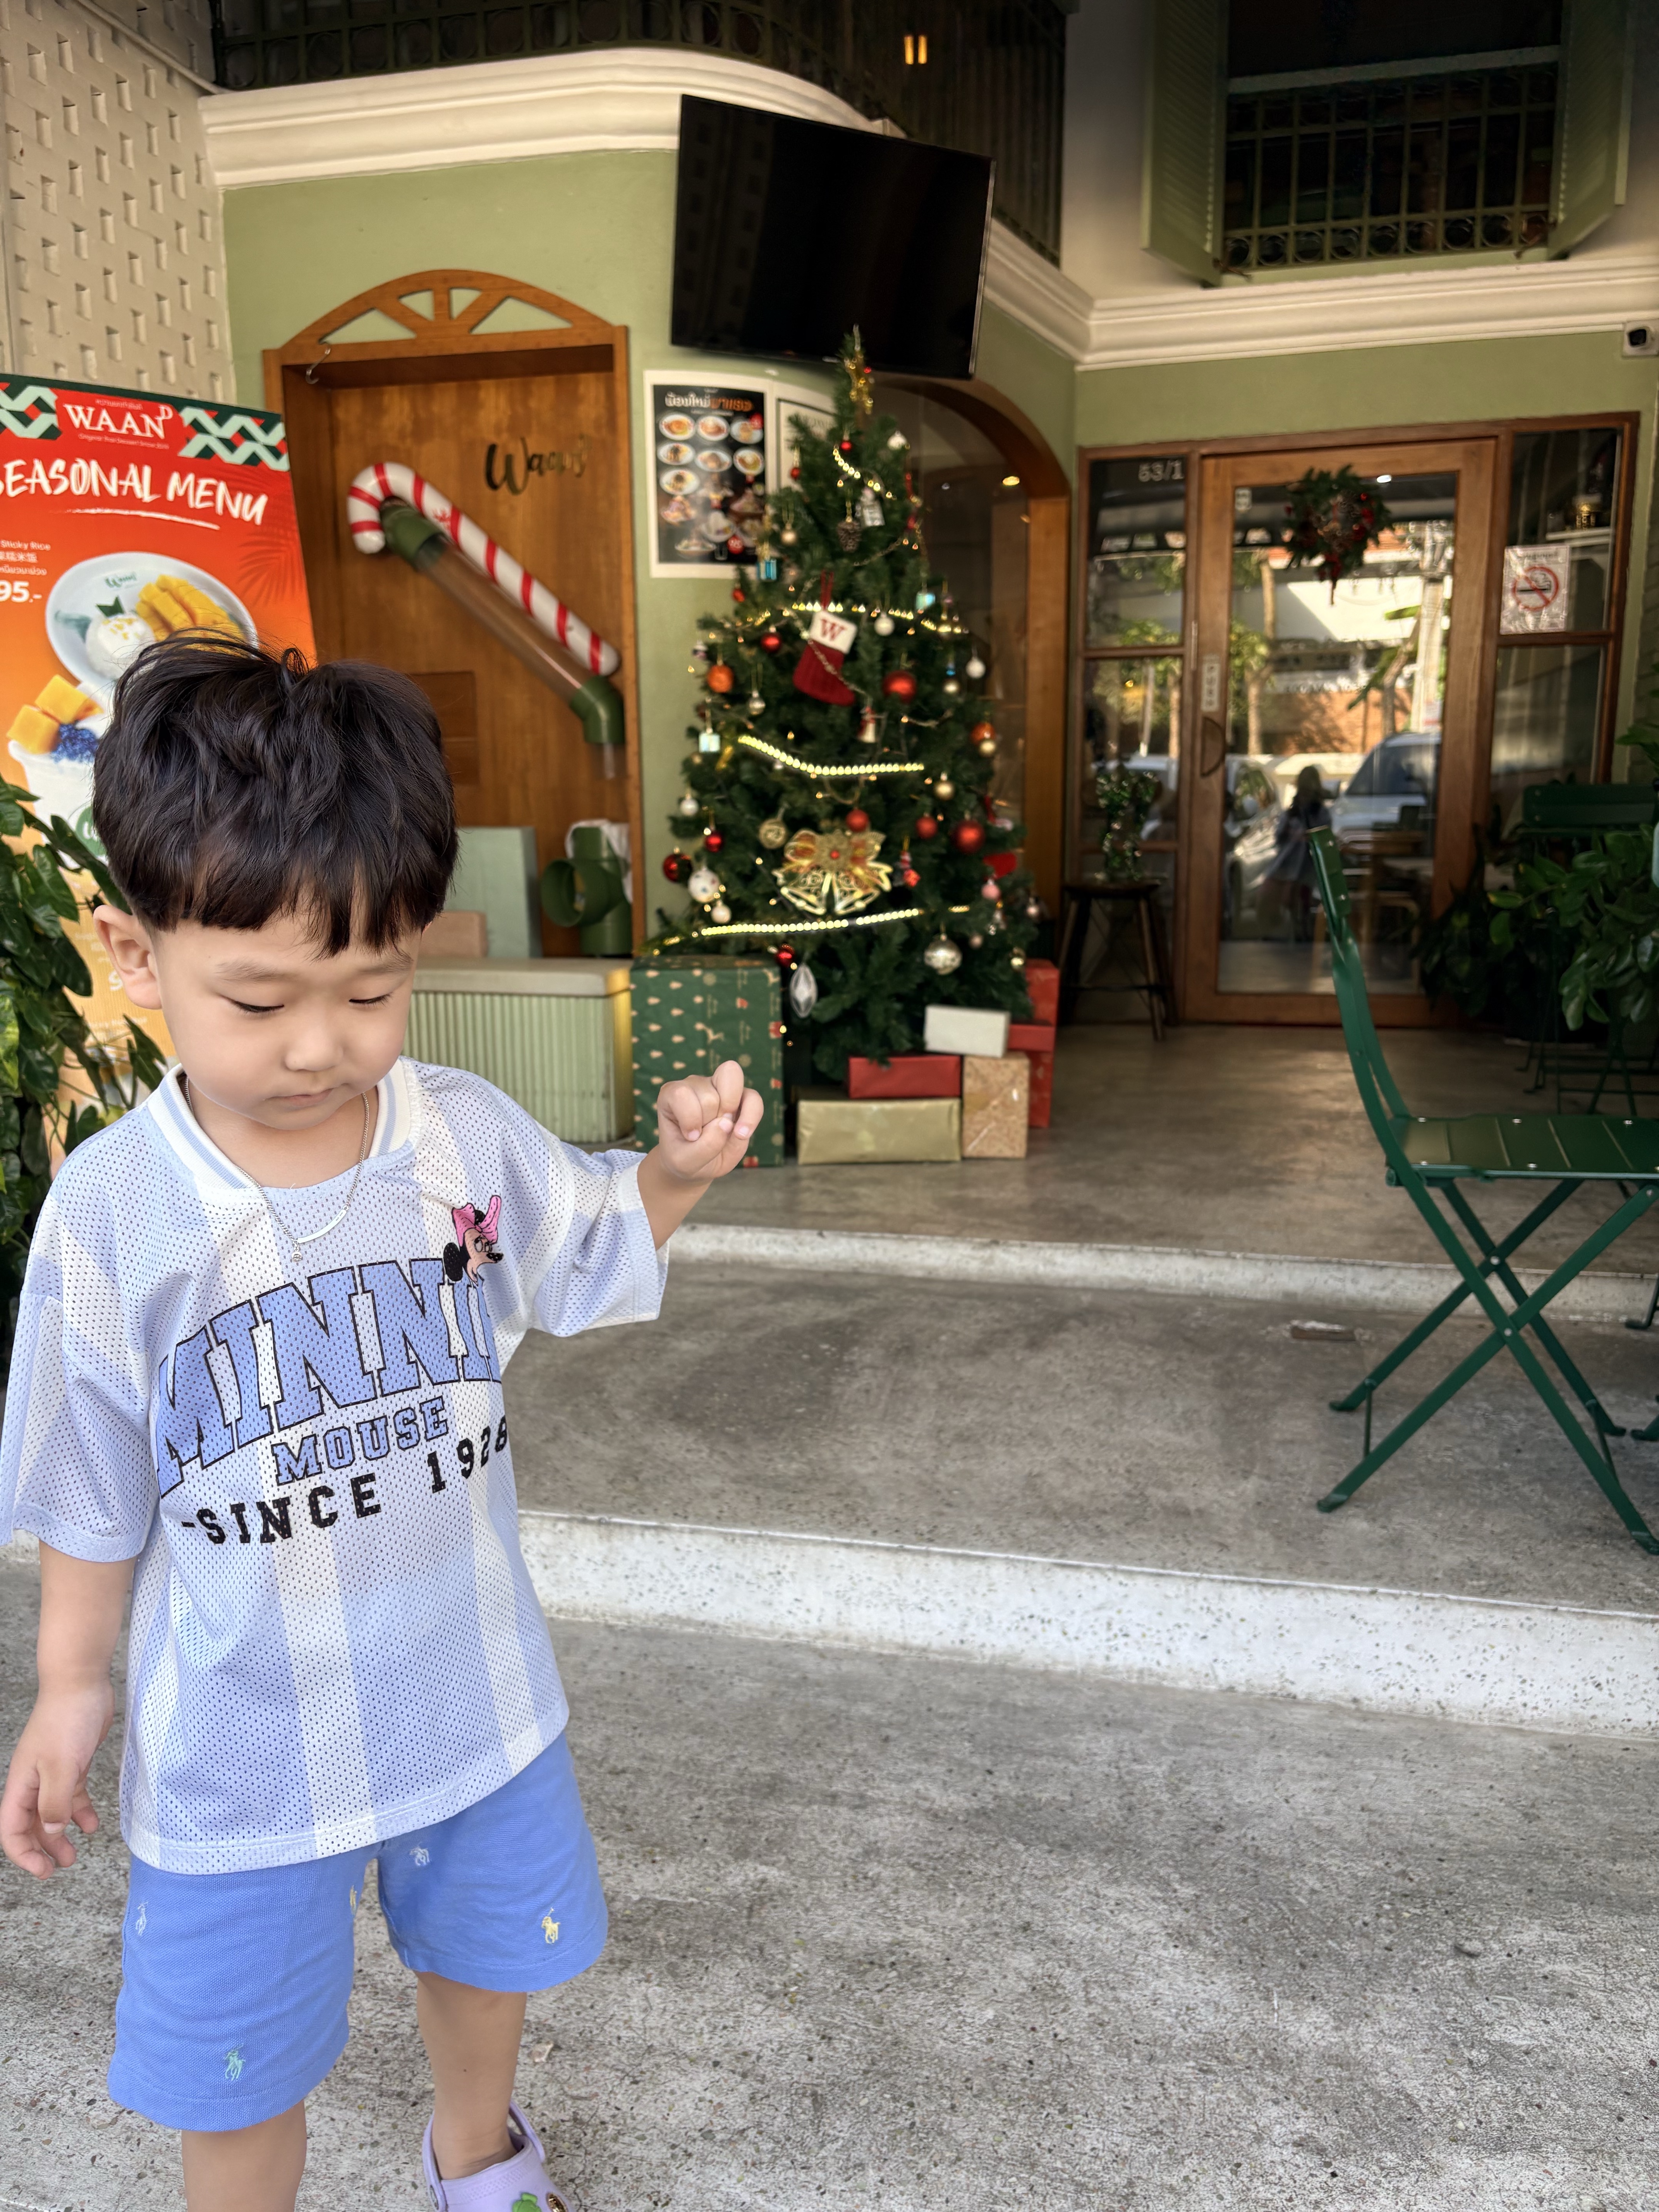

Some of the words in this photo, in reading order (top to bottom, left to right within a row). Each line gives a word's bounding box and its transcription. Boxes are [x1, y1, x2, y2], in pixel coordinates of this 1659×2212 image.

[0, 458, 161, 503] EASONAL
[167, 472, 268, 525] MENU
[821, 618, 847, 641] W
[272, 1395, 449, 1486] MOUSE
[427, 1415, 507, 1494] 1928
